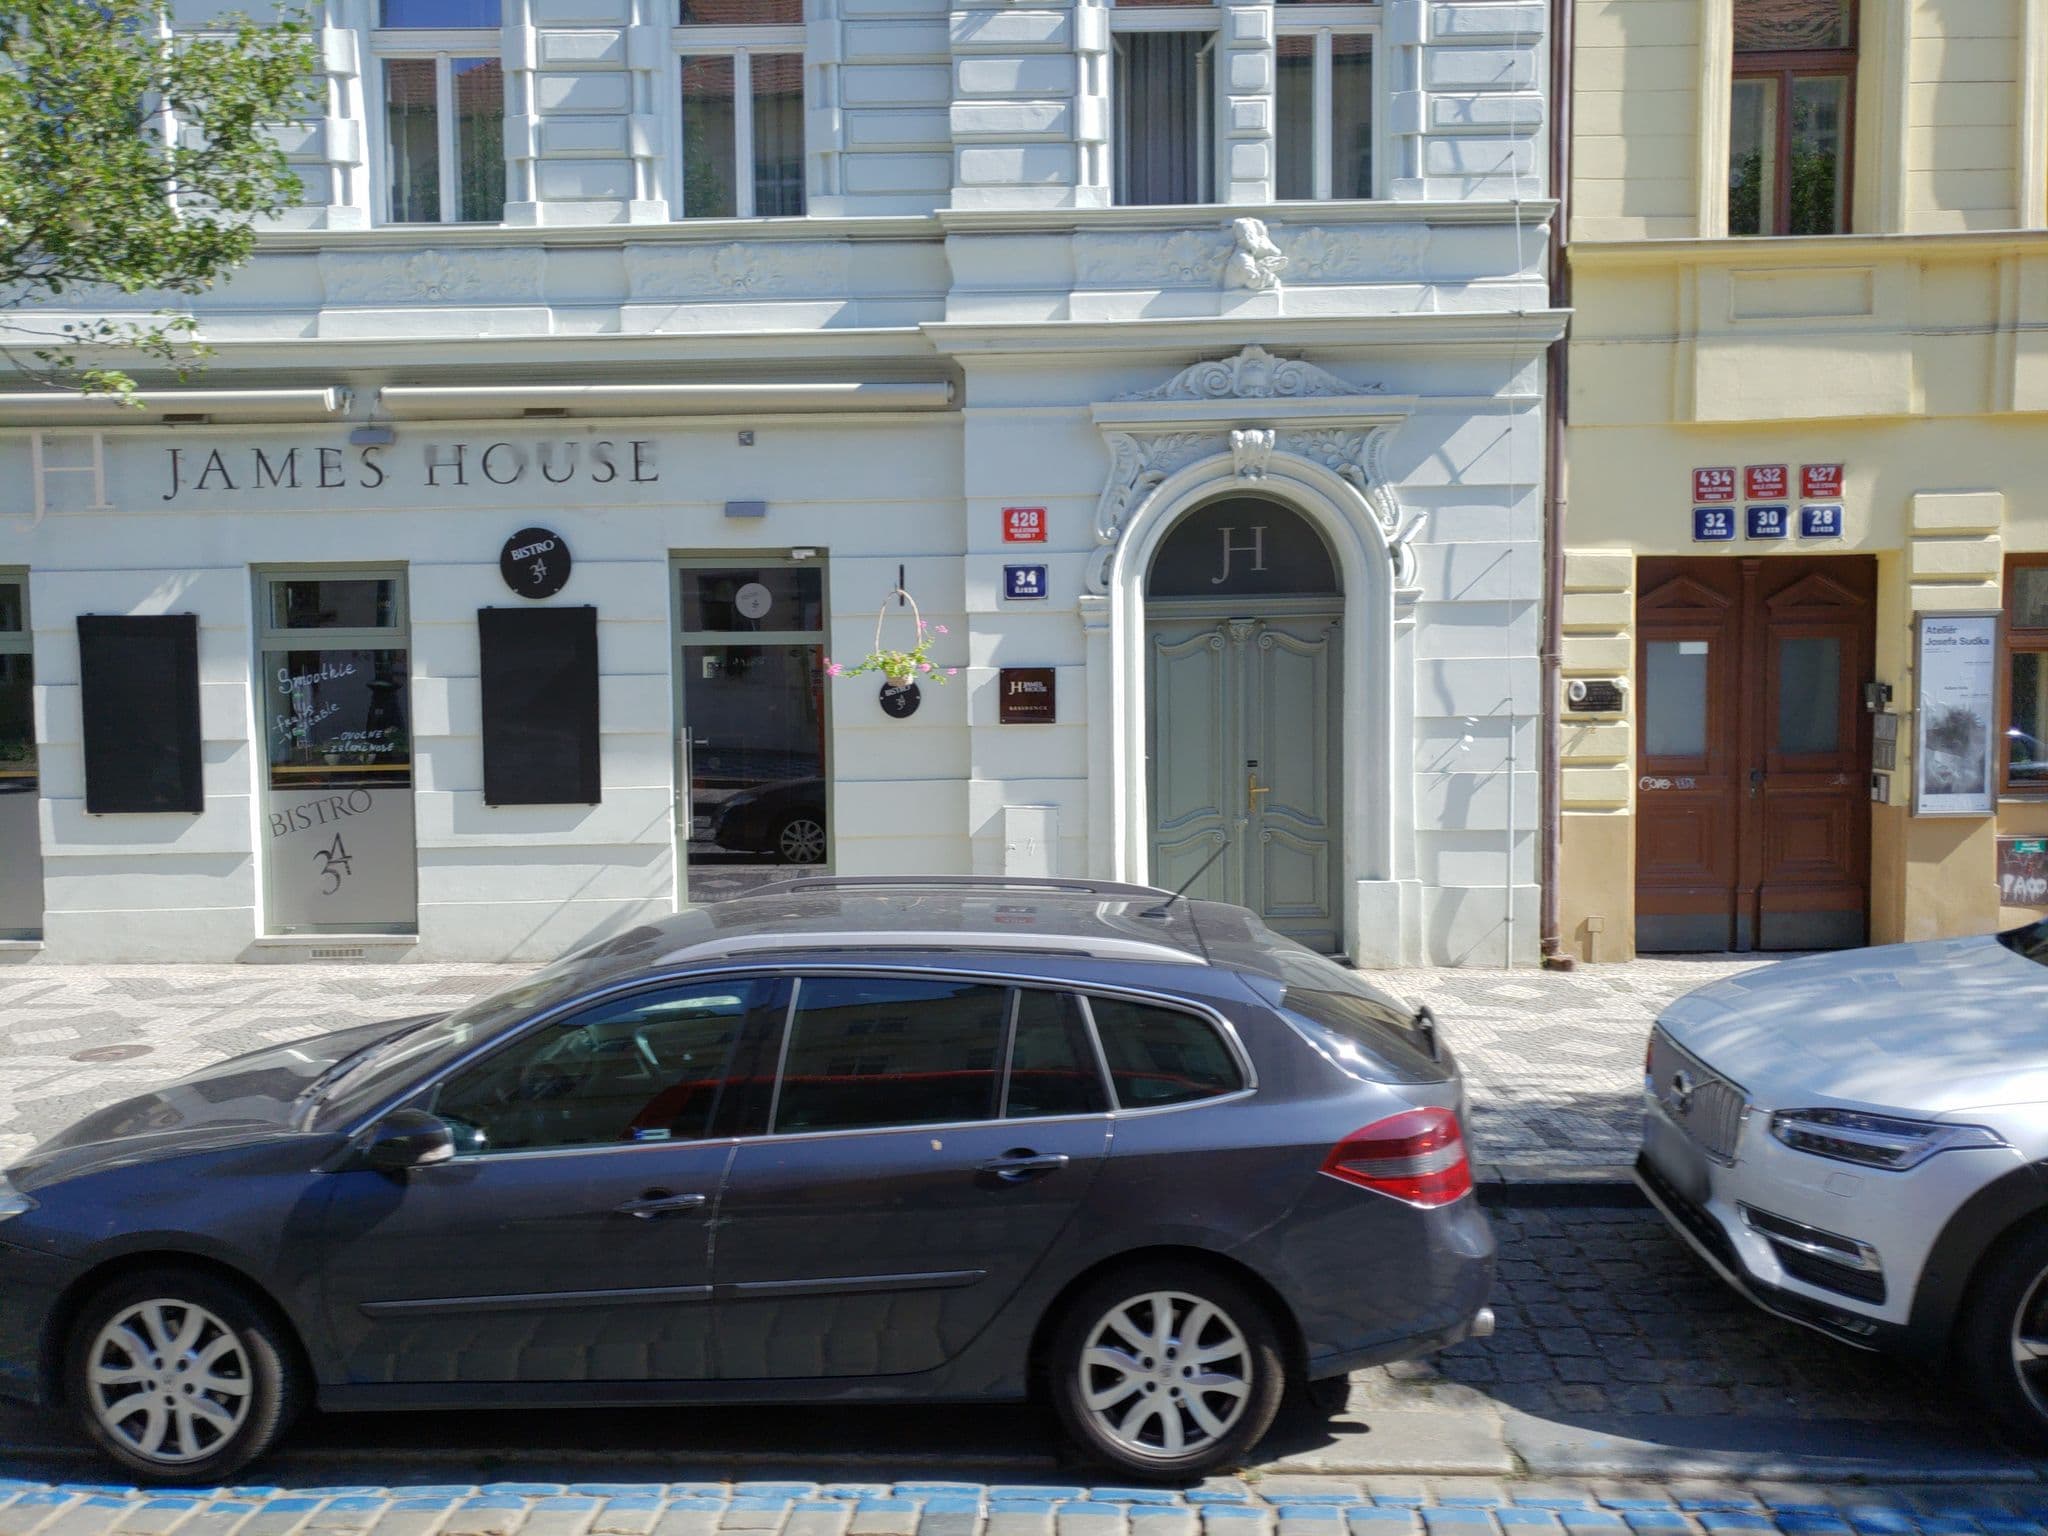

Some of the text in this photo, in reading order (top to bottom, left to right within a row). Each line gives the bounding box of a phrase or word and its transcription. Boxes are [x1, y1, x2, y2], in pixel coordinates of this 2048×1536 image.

[163, 441, 659, 500] JAMES HOUSE
[1753, 469, 1781, 482] 432
[1808, 468, 1836, 481] 427
[1699, 471, 1731, 486] 434
[1010, 511, 1039, 527] 428
[1704, 513, 1726, 528] 32
[1757, 511, 1779, 526] 30
[1812, 510, 1834, 525] 28
[510, 539, 555, 561] BISTRO
[1211, 526, 1268, 585] JH
[1015, 570, 1038, 585] 34
[269, 789, 373, 838] BISTRO
